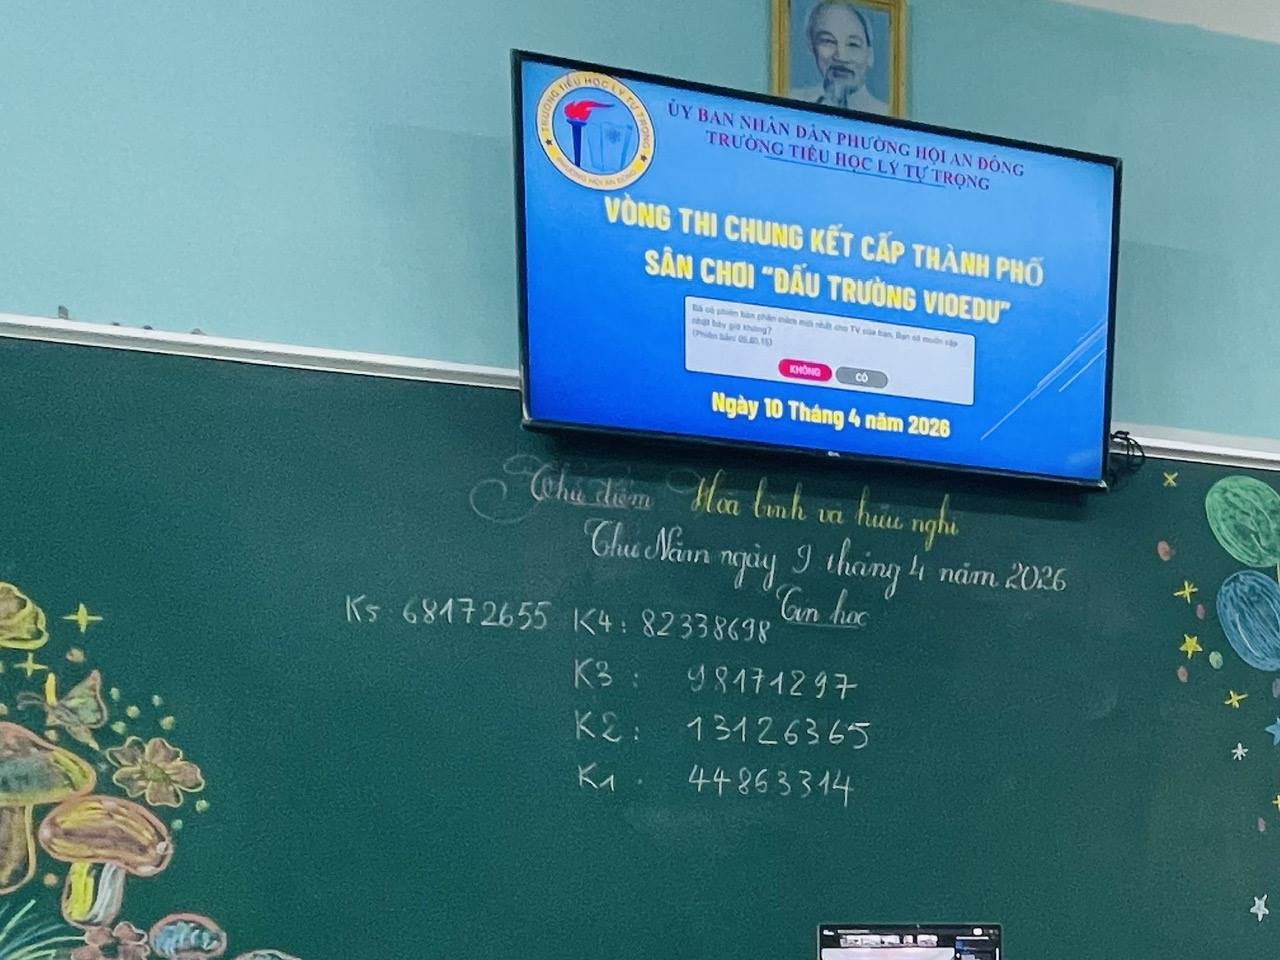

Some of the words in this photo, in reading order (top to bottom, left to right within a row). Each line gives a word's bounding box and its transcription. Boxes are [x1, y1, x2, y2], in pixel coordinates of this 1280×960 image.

[697, 107, 734, 128] BAN
[740, 116, 790, 136] NHÂN
[796, 124, 831, 143] DÂN
[837, 132, 911, 156] PHƯỜNG
[915, 146, 946, 165] HỘI
[951, 153, 973, 167] AN
[705, 130, 784, 156] TRƯỜNG
[789, 143, 830, 163] TIỂU
[835, 151, 873, 173] HỌC
[877, 159, 900, 175] LÝ
[903, 163, 929, 184] TỰ
[931, 168, 990, 190] TRỌNG
[604, 193, 672, 231] VÒNG
[678, 207, 718, 237] THI
[724, 214, 804, 250] CHUNG
[810, 223, 855, 258] KẾT
[861, 231, 906, 265] CẤP
[912, 243, 990, 279] THÀNH
[995, 256, 1045, 287] PHỐ
[644, 246, 694, 281] SÂN
[700, 257, 755, 290] CHƠI
[826, 275, 917, 312] TRƯỜNG
[850, 324, 860, 334] TV
[789, 363, 822, 378] KHÔNG
[855, 371, 869, 384] CÓ
[711, 391, 760, 421] Ngày
[764, 397, 784, 419] 10
[788, 400, 845, 431] Tháng
[848, 408, 861, 429] 4
[865, 411, 904, 433] năm
[908, 415, 951, 438] 2026
[720, 543, 777, 592] ngày
[792, 543, 813, 574] 9
[826, 536, 901, 600] tháng
[908, 553, 925, 581] 4
[940, 562, 999, 588] năm
[1004, 561, 1067, 592] 2026
[402, 597, 552, 631] 68172655
[641, 607, 771, 645] 82338698
[687, 714, 871, 750] 13126365
[687, 763, 854, 808] 44863314
